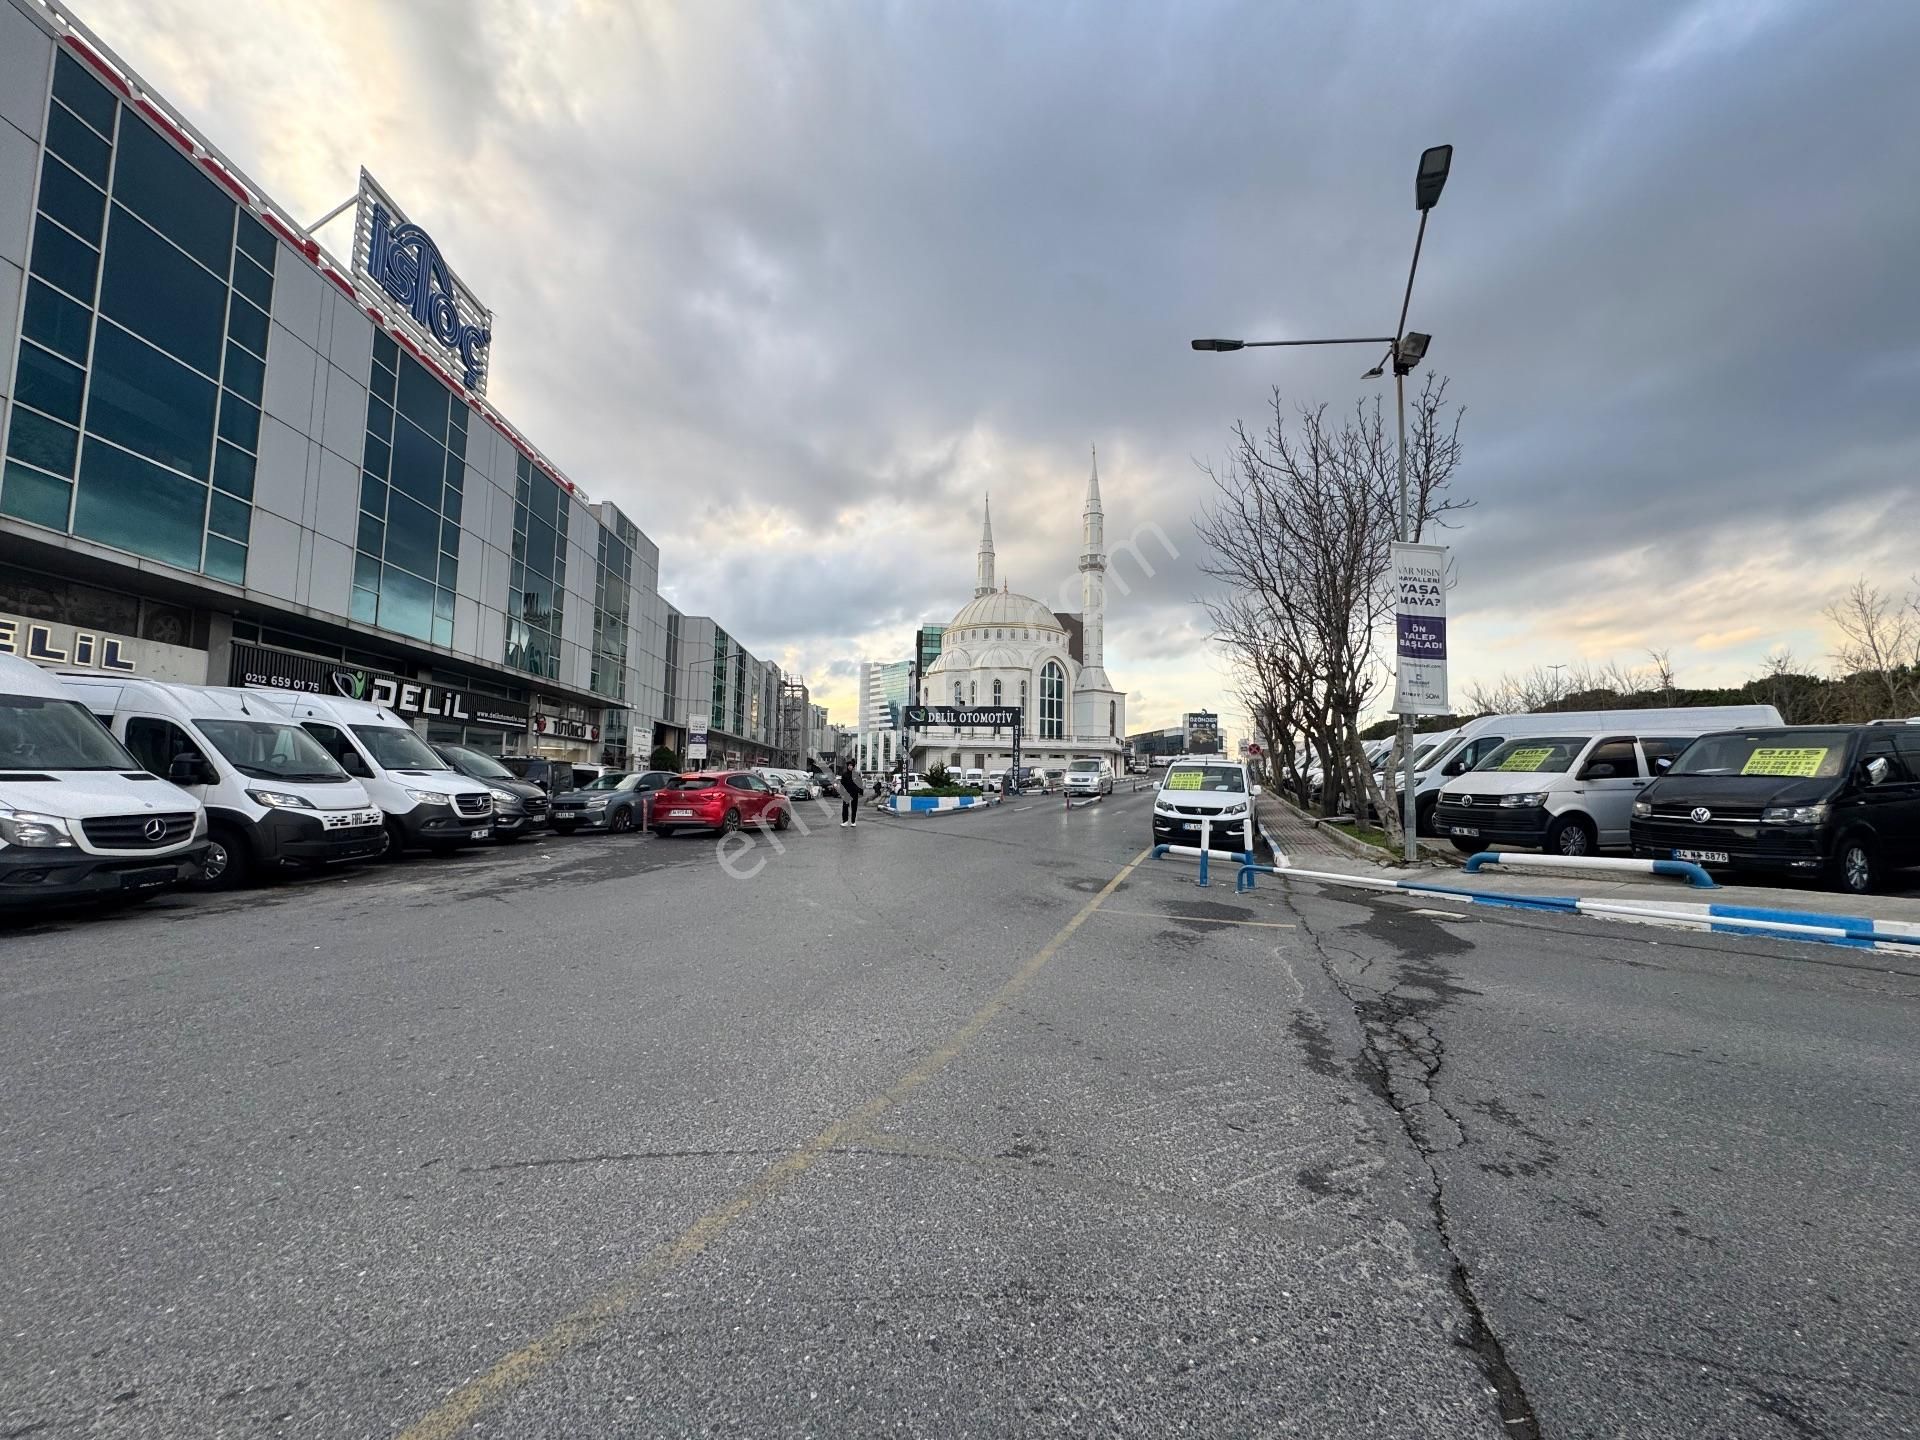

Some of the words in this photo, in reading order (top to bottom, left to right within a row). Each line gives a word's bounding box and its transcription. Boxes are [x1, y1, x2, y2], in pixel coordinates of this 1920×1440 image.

[1399, 583, 1440, 597] YAŞA
[1400, 596, 1441, 607] MAYA?
[1412, 624, 1426, 632] ÖN
[1404, 632, 1436, 641] TALEP
[1399, 639, 1443, 649] BAŞLADI
[245, 672, 267, 684] 0212
[271, 675, 291, 688] 659
[293, 680, 305, 690] 01
[308, 681, 320, 692] 75
[928, 710, 956, 723] DELİL
[959, 710, 1013, 724] OTOMOTİV
